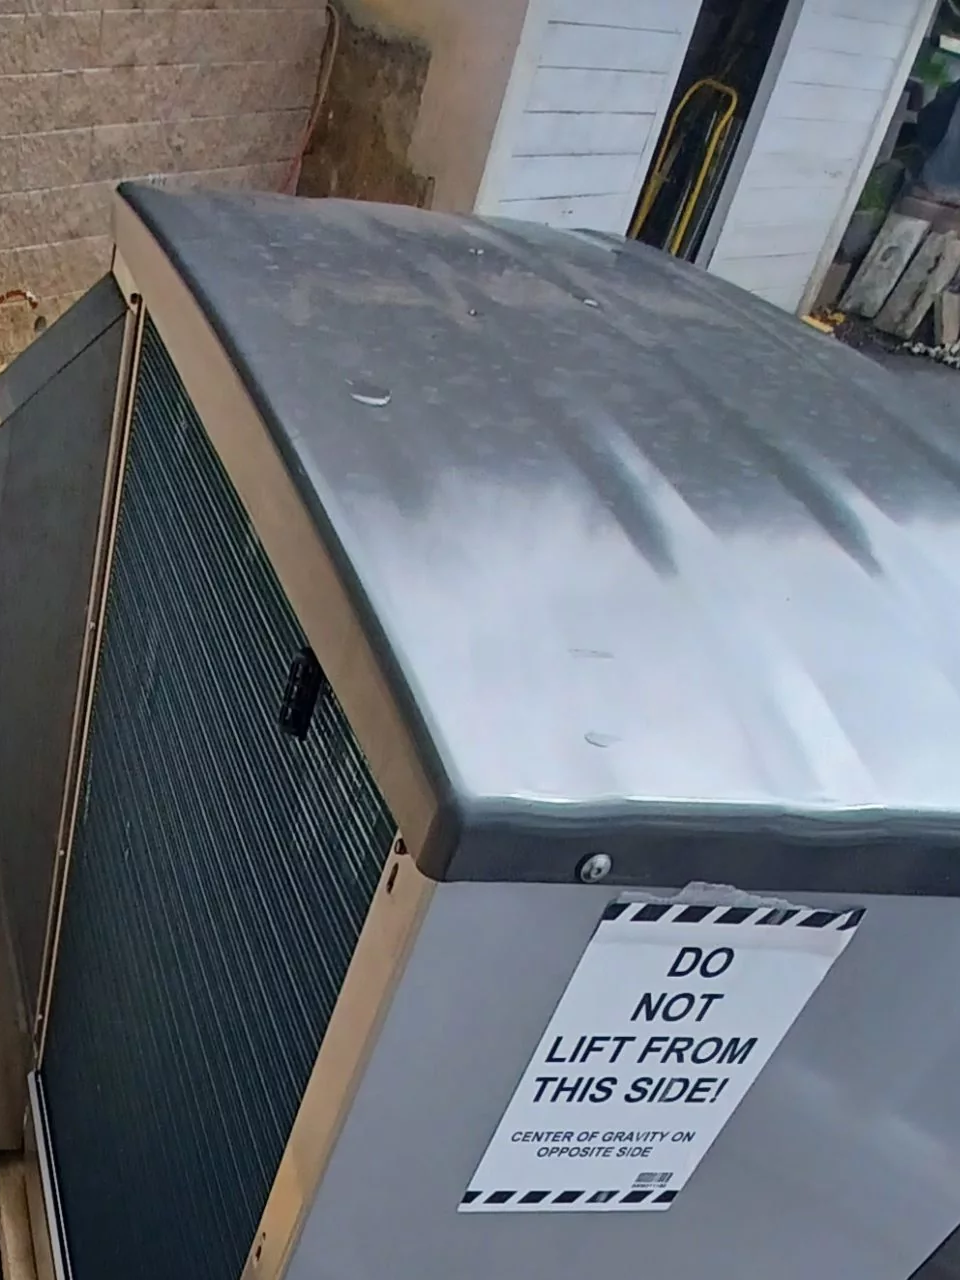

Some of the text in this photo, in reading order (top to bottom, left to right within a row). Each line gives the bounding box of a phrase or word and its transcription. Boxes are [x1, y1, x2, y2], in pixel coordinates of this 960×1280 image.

[667, 946, 735, 978] DO
[630, 992, 724, 1021] NOT
[545, 1036, 759, 1065] LIFT FROM
[532, 1076, 730, 1104] THIS SIDE!
[511, 1131, 696, 1143] CENTER OF GRAVITY ON
[536, 1146, 653, 1158] OPPOSITE SIDE
